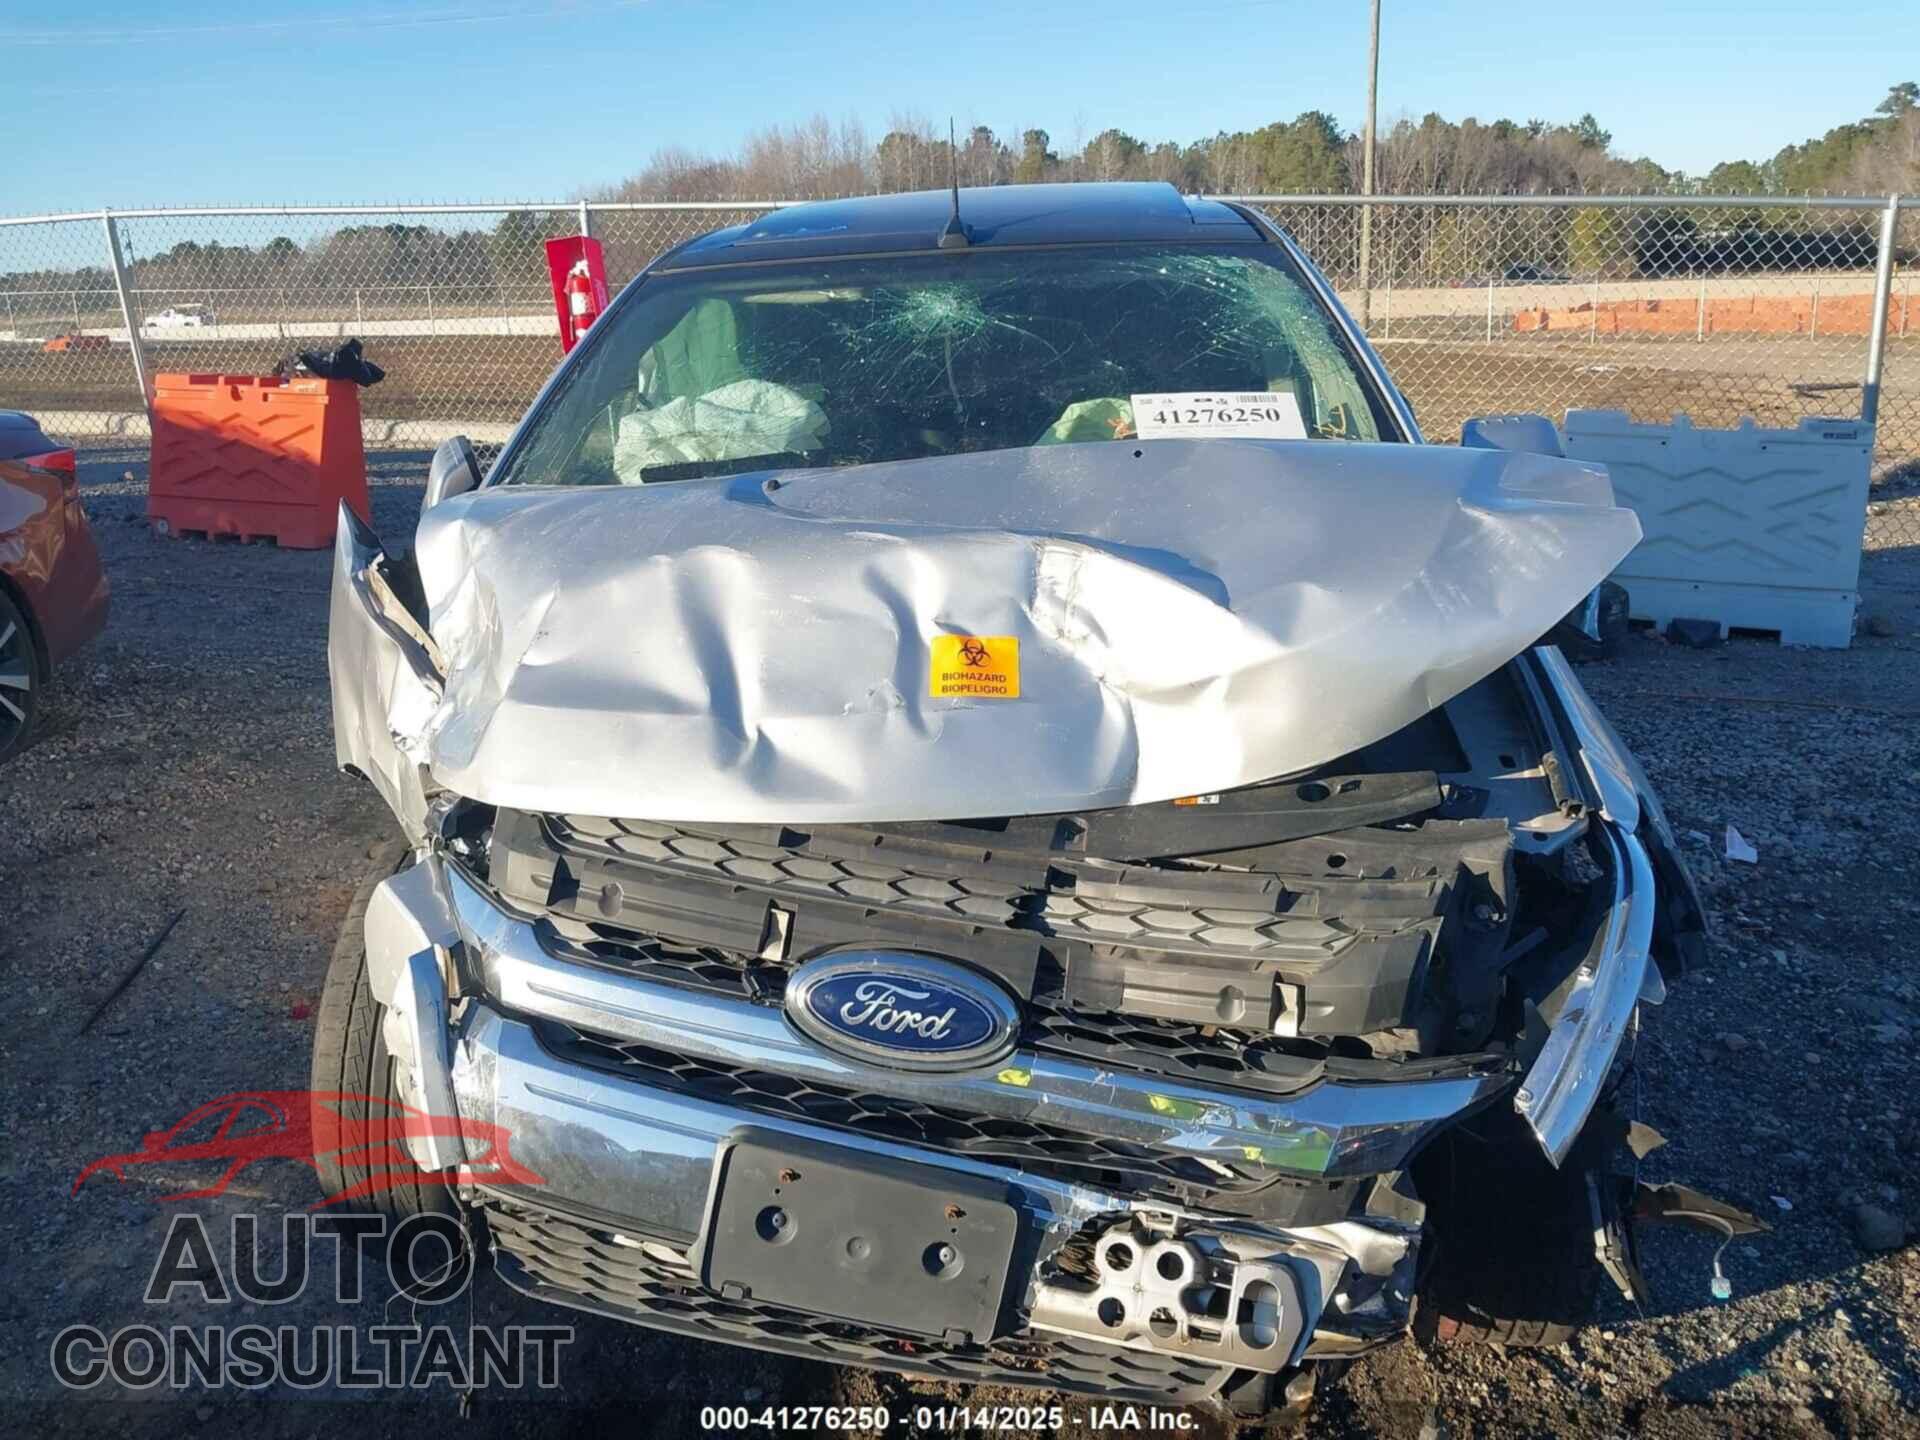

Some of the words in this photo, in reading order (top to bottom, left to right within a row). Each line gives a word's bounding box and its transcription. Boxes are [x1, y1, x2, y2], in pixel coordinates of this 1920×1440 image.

[1153, 408, 1280, 424] 41276250
[942, 672, 1006, 683] BIOHAZARD
[941, 684, 1007, 695] BIOPELIGRO
[840, 981, 957, 1040] Ford
